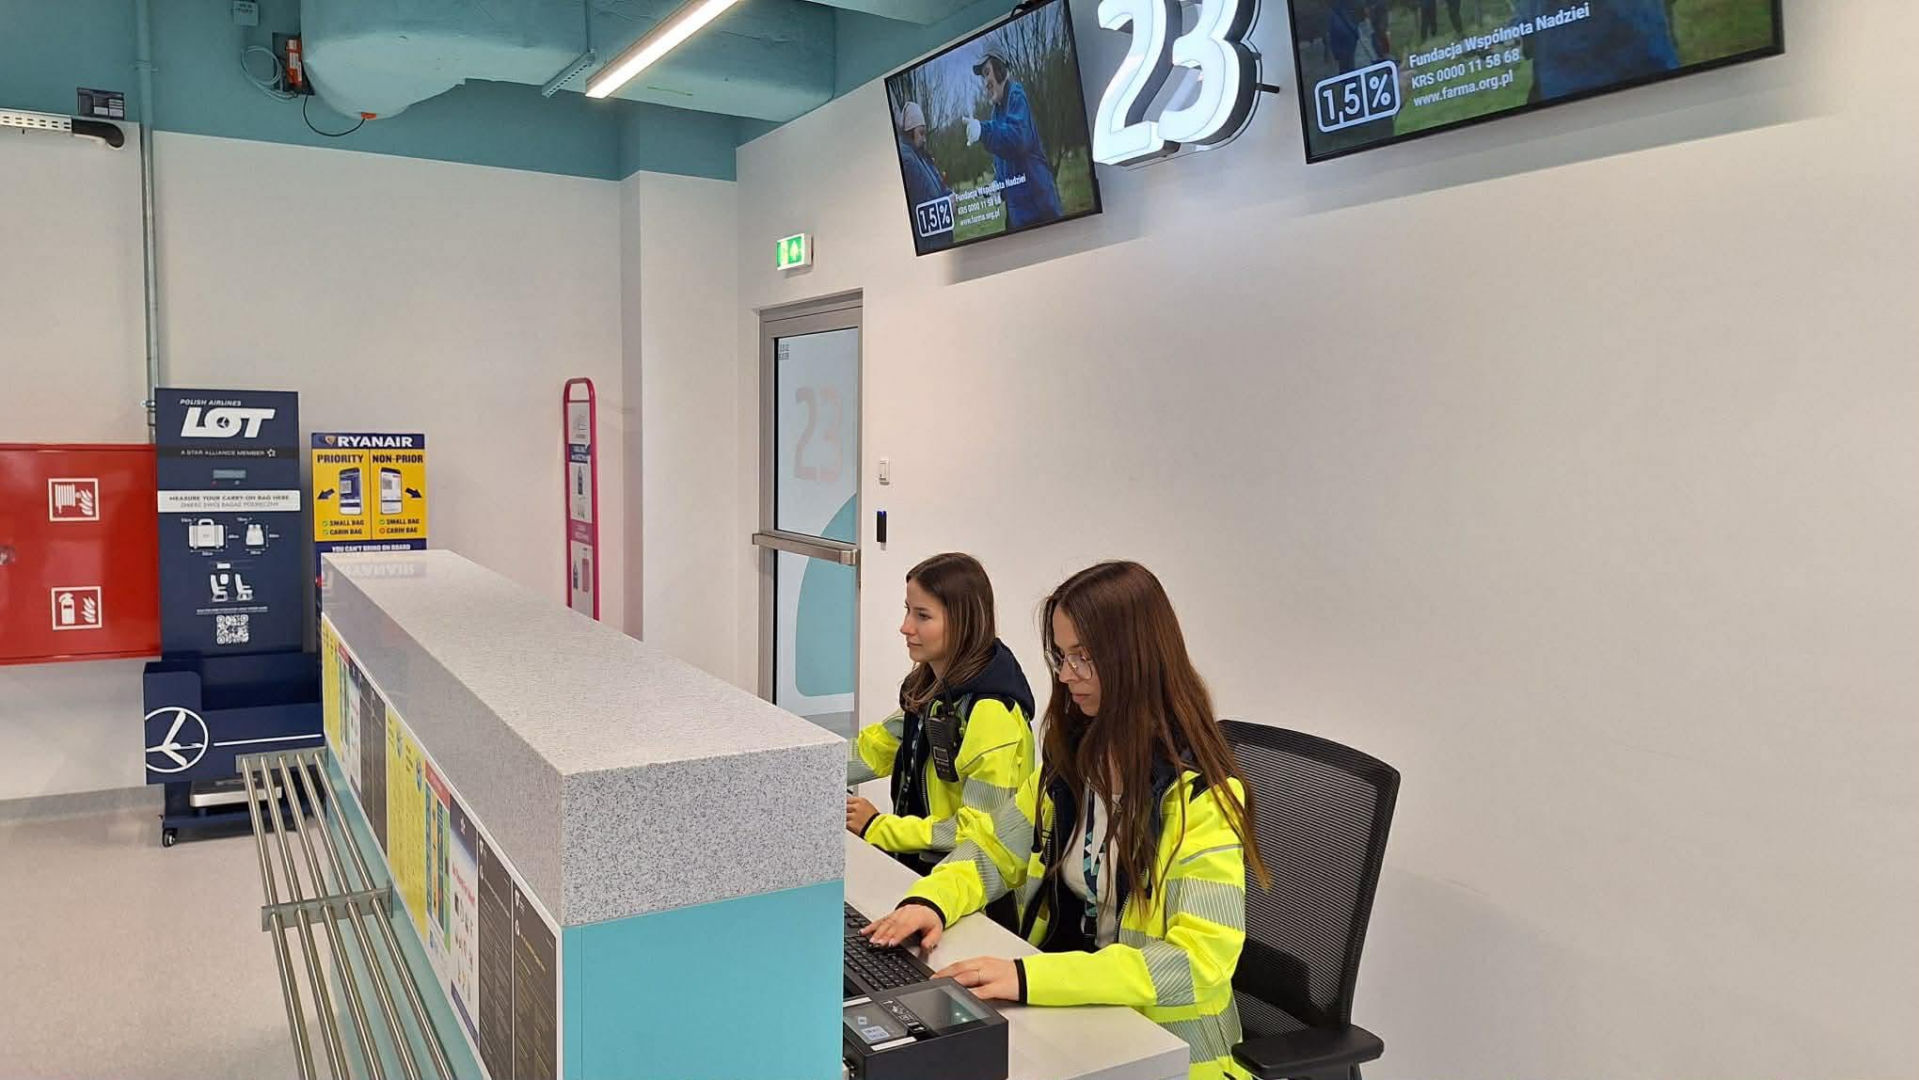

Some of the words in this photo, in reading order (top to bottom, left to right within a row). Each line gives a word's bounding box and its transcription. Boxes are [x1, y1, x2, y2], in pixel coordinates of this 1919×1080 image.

[1409, 42, 1463, 68] Fundacja
[1464, 22, 1534, 51] Wspólnota
[1535, 2, 1590, 31] Nadziei
[1092, 0, 1244, 165] 23
[1411, 72, 1435, 90] KRS
[1436, 63, 1466, 82] 0000
[1468, 59, 1482, 74] 11
[1485, 53, 1502, 69] 58
[1504, 47, 1521, 64] 68
[1413, 69, 1514, 107] www.farma.org.pl
[208, 399, 241, 407] AIRLINES
[180, 407, 276, 438] LOT
[794, 385, 844, 482] 23
[337, 435, 413, 448] RYANAIR
[317, 454, 364, 464] PRIORITY
[372, 454, 424, 464] NON-PRIOR
